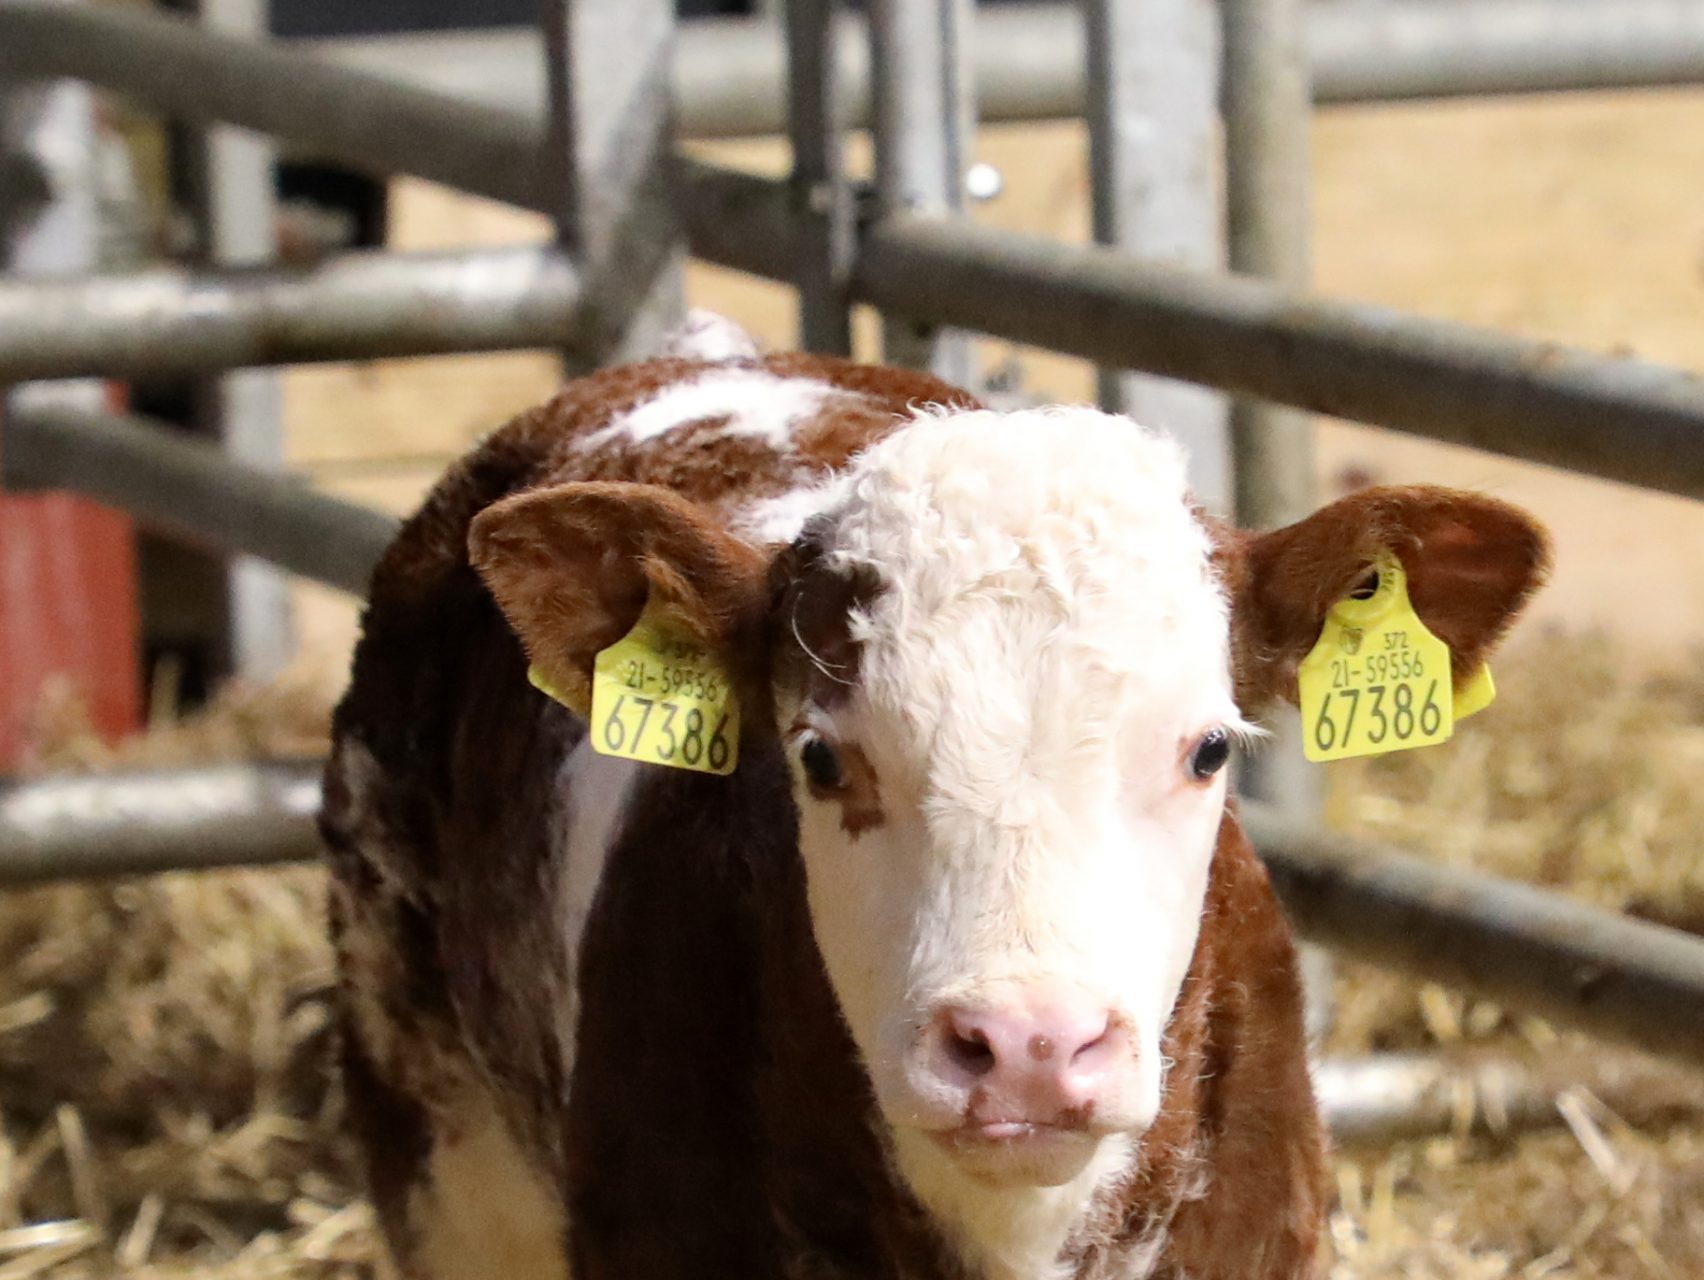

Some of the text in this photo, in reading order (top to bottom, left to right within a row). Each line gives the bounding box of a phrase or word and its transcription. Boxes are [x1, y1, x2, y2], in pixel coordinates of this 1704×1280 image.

[1384, 631, 1408, 650] 372
[627, 661, 718, 702] 21-59556
[1332, 651, 1424, 688] 21-59556
[604, 695, 730, 770] 67386
[1315, 680, 1441, 751] 67386
